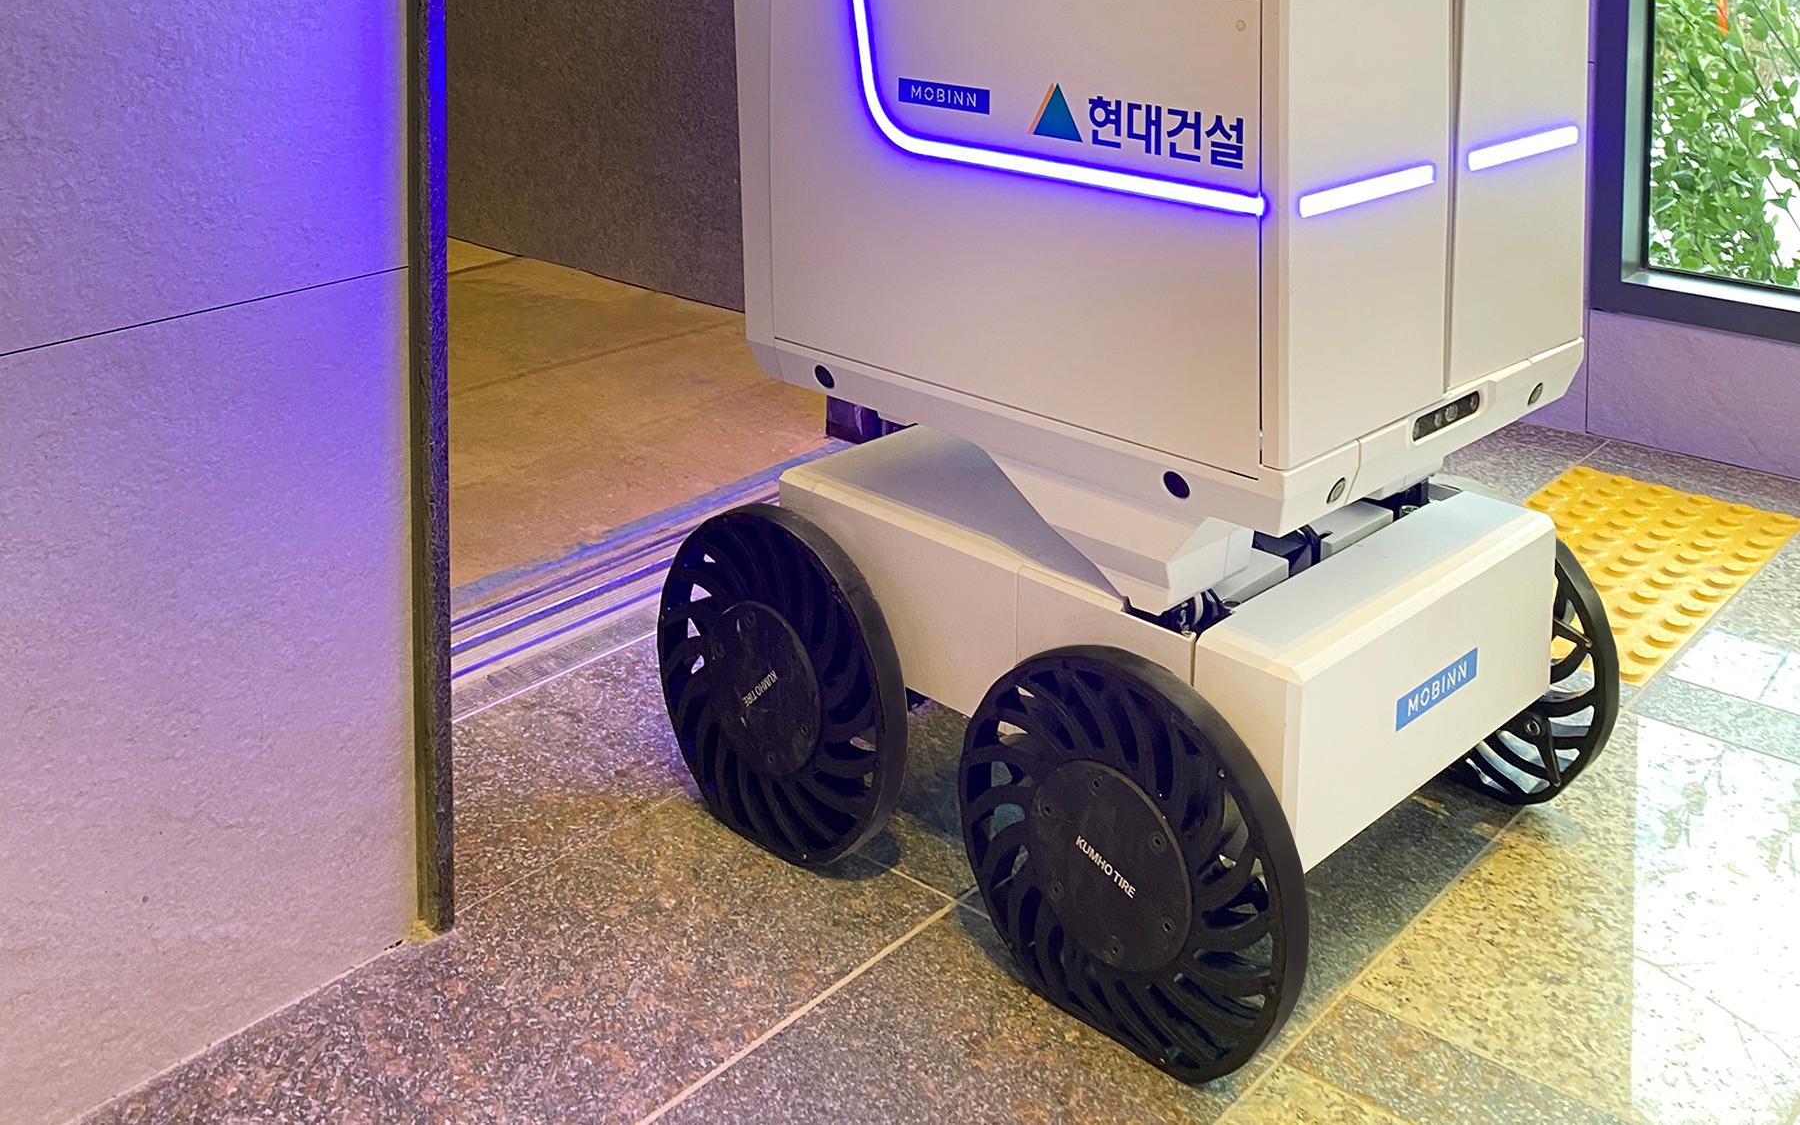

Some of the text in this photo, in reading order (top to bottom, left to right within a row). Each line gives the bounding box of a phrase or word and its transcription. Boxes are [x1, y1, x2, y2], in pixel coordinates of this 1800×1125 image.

[911, 84, 977, 108] MOBINN
[1088, 95, 1244, 170] 현대건설
[742, 669, 779, 708] KUMHO TIRE
[1407, 660, 1468, 717] MOBINN
[1075, 835, 1137, 899] KUMHO TIRE
